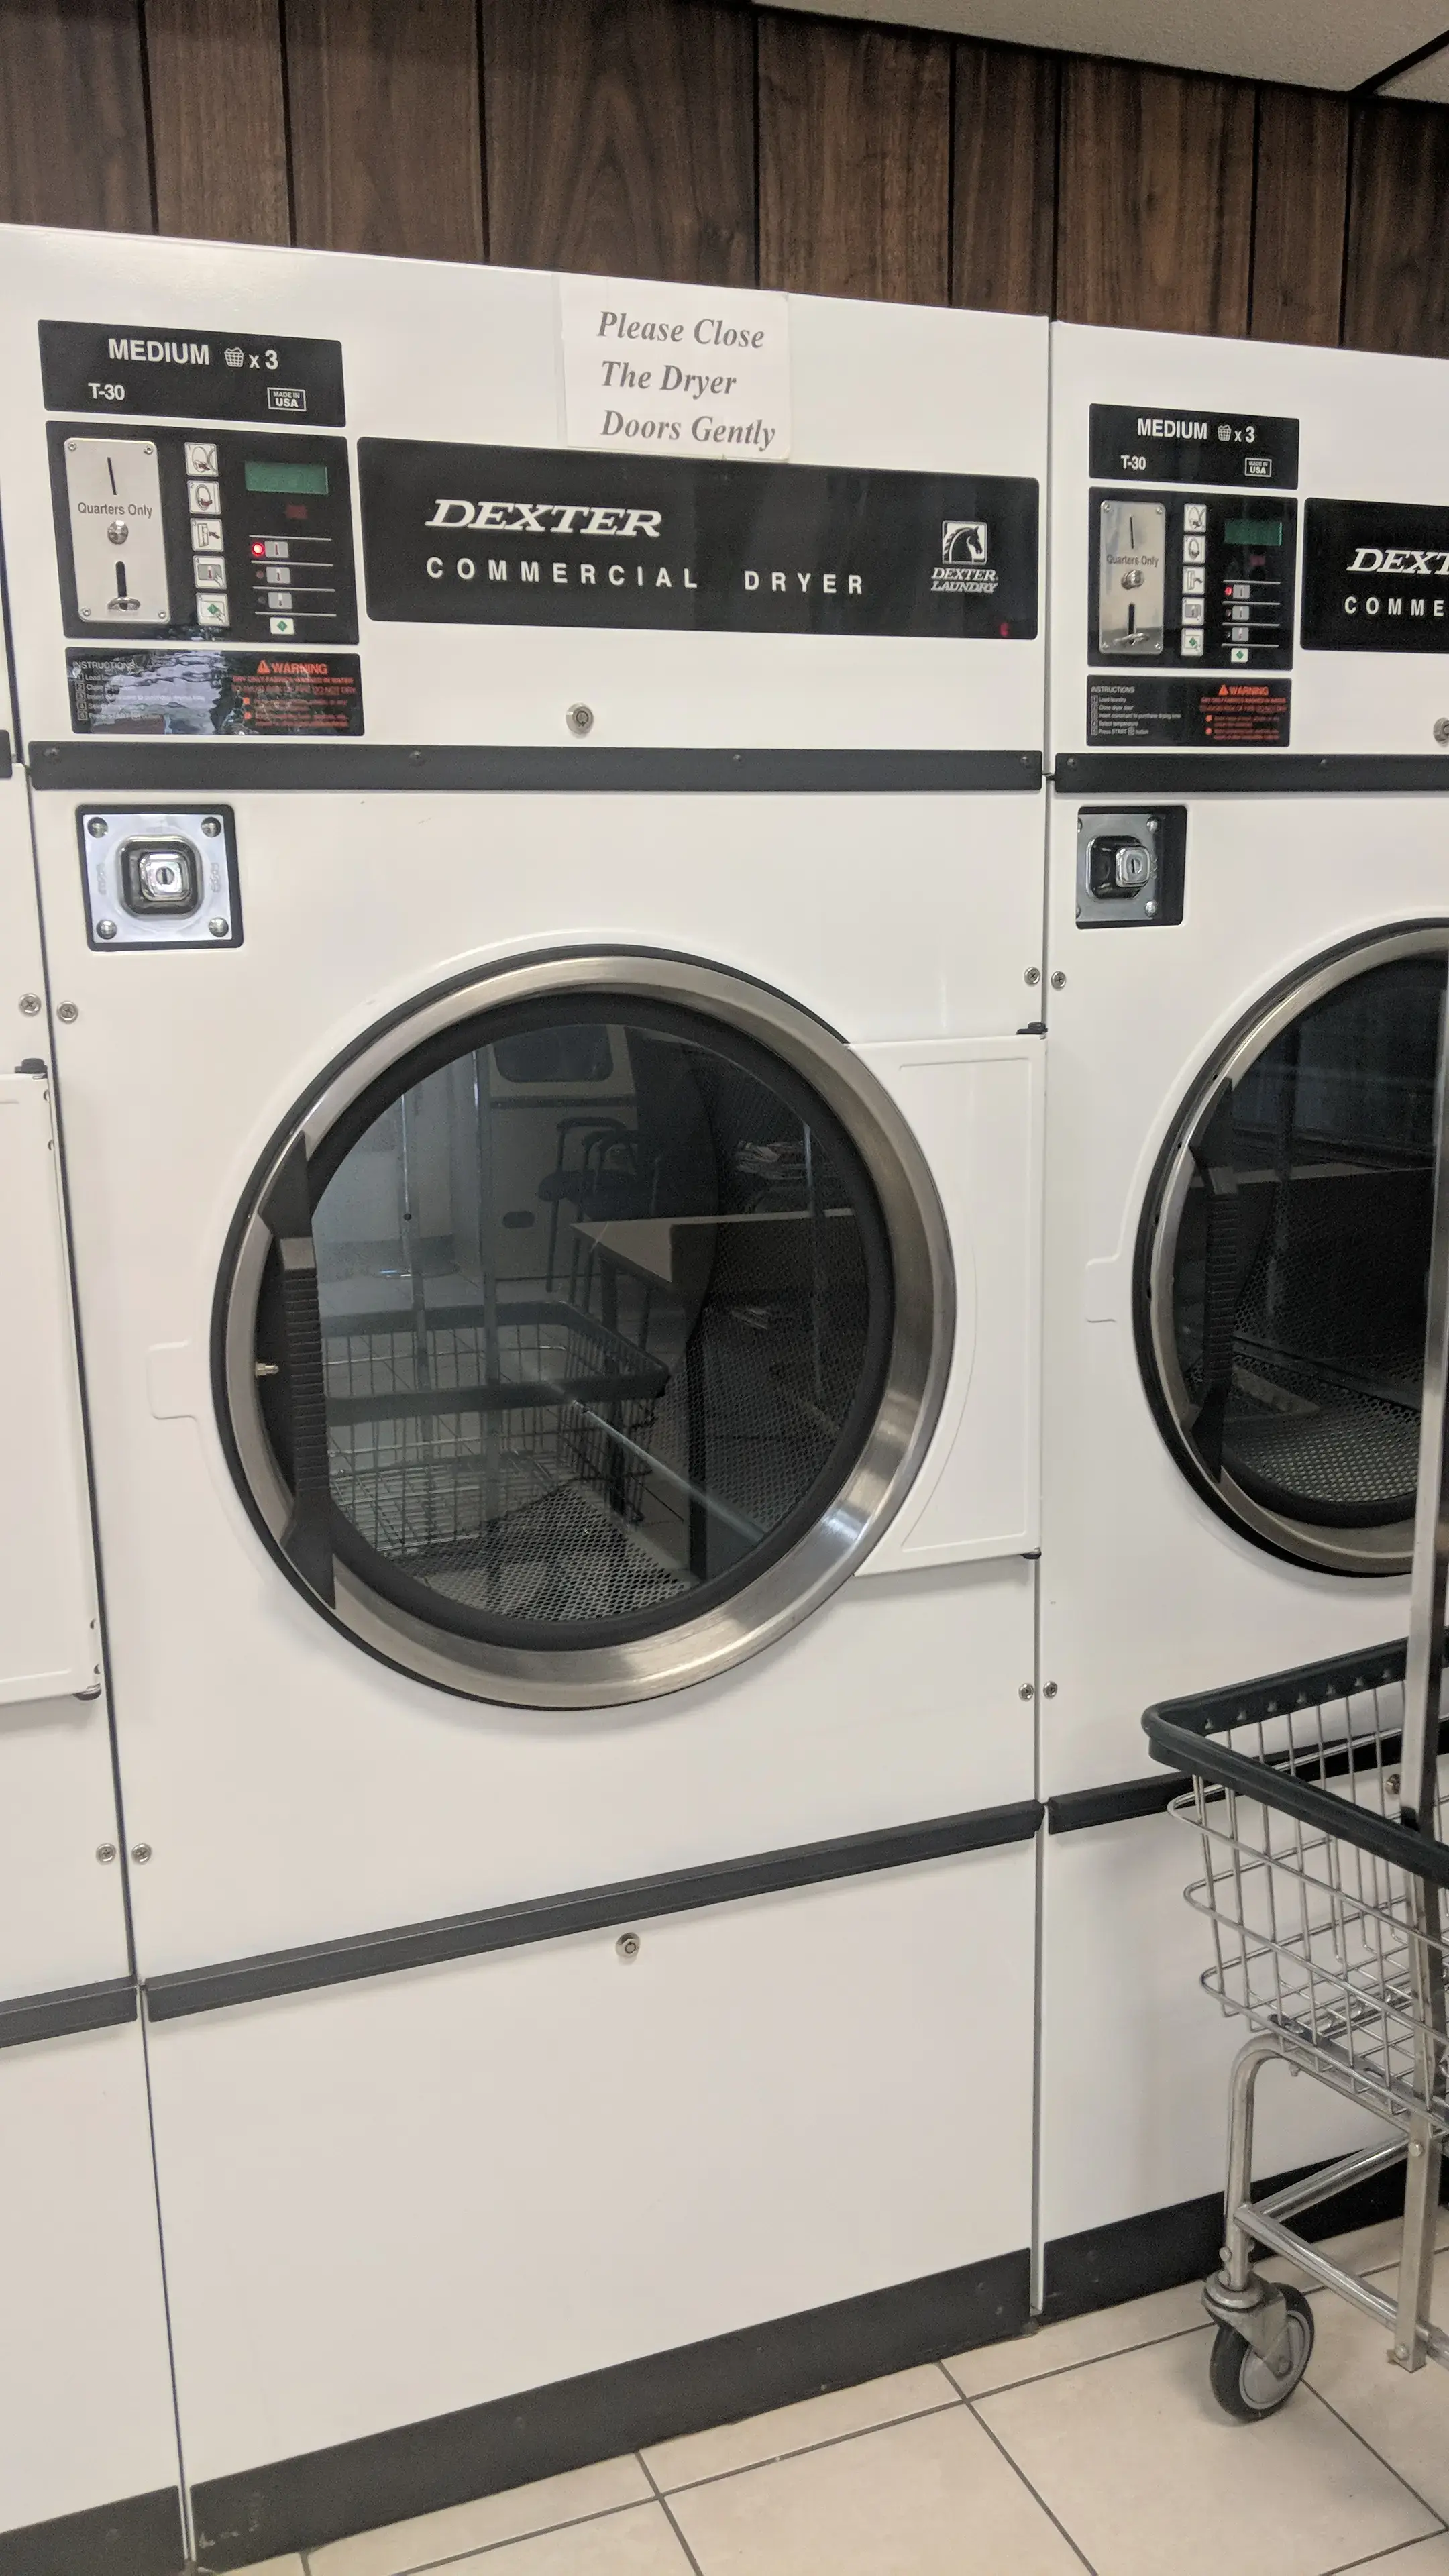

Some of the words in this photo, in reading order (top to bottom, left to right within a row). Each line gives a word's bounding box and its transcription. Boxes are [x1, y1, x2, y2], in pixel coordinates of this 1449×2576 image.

[598, 311, 684, 343] Please
[694, 318, 764, 349] Close
[109, 338, 210, 366] MEDIUM
[249, 355, 260, 369] x
[265, 350, 278, 370] 3
[602, 360, 652, 390] The
[659, 365, 737, 400] Dryer
[88, 383, 125, 401] T-30
[275, 398, 299, 408] USA
[600, 410, 681, 440] Doors
[691, 415, 775, 452] Gently
[1137, 417, 1208, 440] MEDIUM
[1234, 431, 1242, 443] x
[1245, 425, 1255, 443] 3
[1121, 455, 1146, 470] T-30
[1250, 466, 1266, 474] USA
[77, 502, 124, 515] Quarters
[127, 504, 153, 519] Only
[425, 499, 661, 537] DEXTER
[1106, 554, 1139, 566] Quarters
[1140, 555, 1159, 568] Only
[426, 557, 698, 588] COMMERCIAL
[744, 570, 862, 595] DRYER
[931, 567, 996, 582] DEXTER
[931, 580, 998, 594] LAUNDRY
[1344, 596, 1444, 617] COMME
[271, 662, 328, 674] WARNING
[1091, 686, 1135, 694] INSTRUCTIONS
[1230, 686, 1269, 696] WARNING
